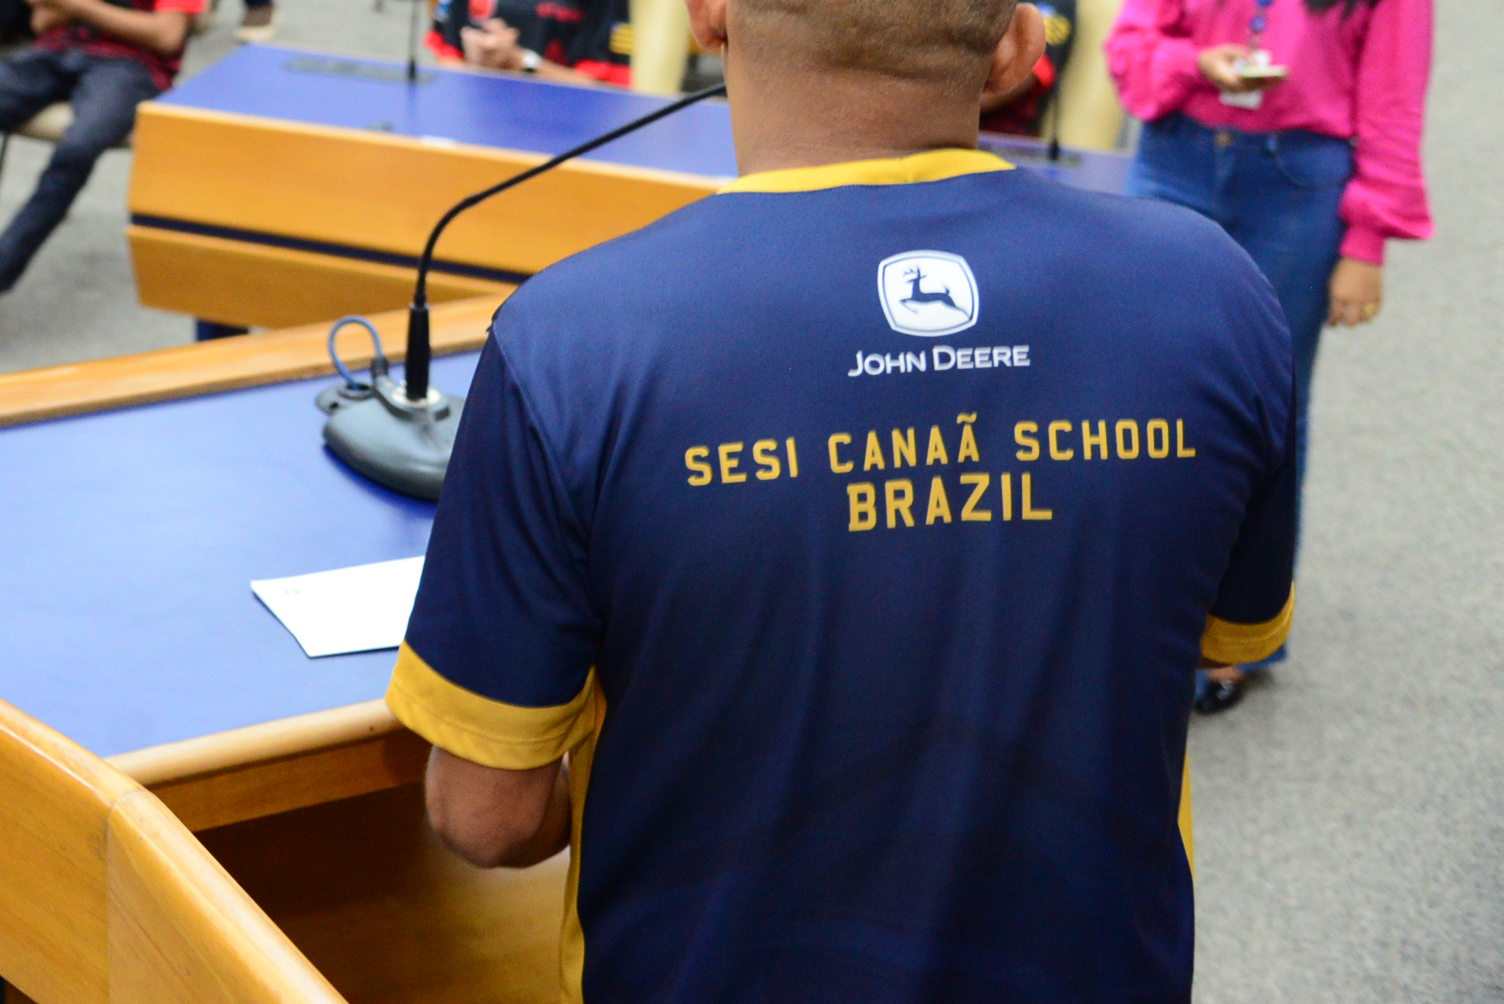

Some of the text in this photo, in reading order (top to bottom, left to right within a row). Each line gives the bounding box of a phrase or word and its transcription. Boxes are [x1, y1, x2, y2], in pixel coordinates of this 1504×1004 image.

[847, 344, 1031, 378] JOHN DEERE
[684, 412, 1197, 487] SESI CANAÃ SCHOOL
[846, 471, 1054, 532] BRAZIL
